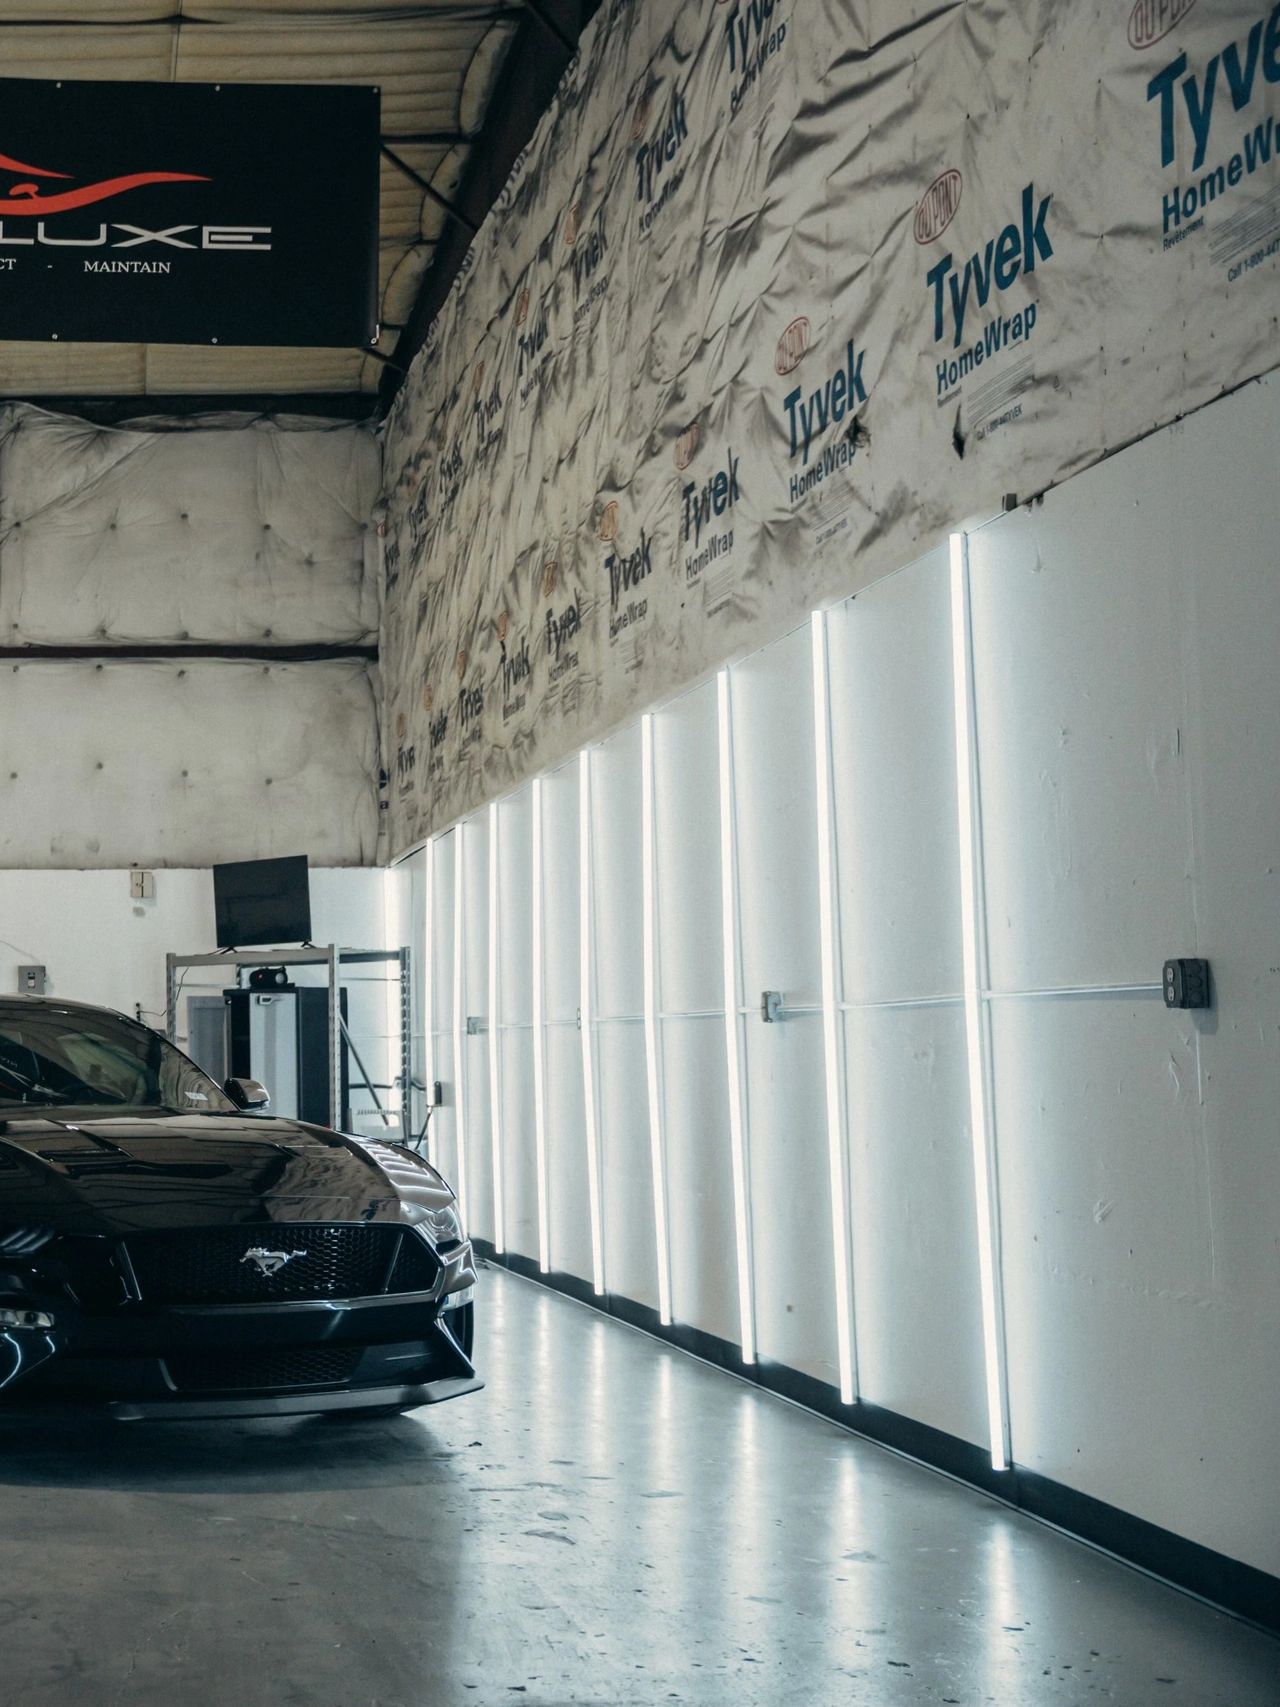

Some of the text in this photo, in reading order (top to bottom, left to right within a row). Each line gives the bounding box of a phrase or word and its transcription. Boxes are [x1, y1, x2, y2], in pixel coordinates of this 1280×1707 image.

[1163, 115, 1280, 233] HomeW
[83, 260, 171, 274] MAINTAIN
[927, 181, 1054, 349] Tyvek
[936, 303, 1038, 395] HomeWrap
[784, 338, 868, 466] Tyvek
[790, 440, 857, 503] HomeWrap
[686, 528, 734, 580] HomeWrap
